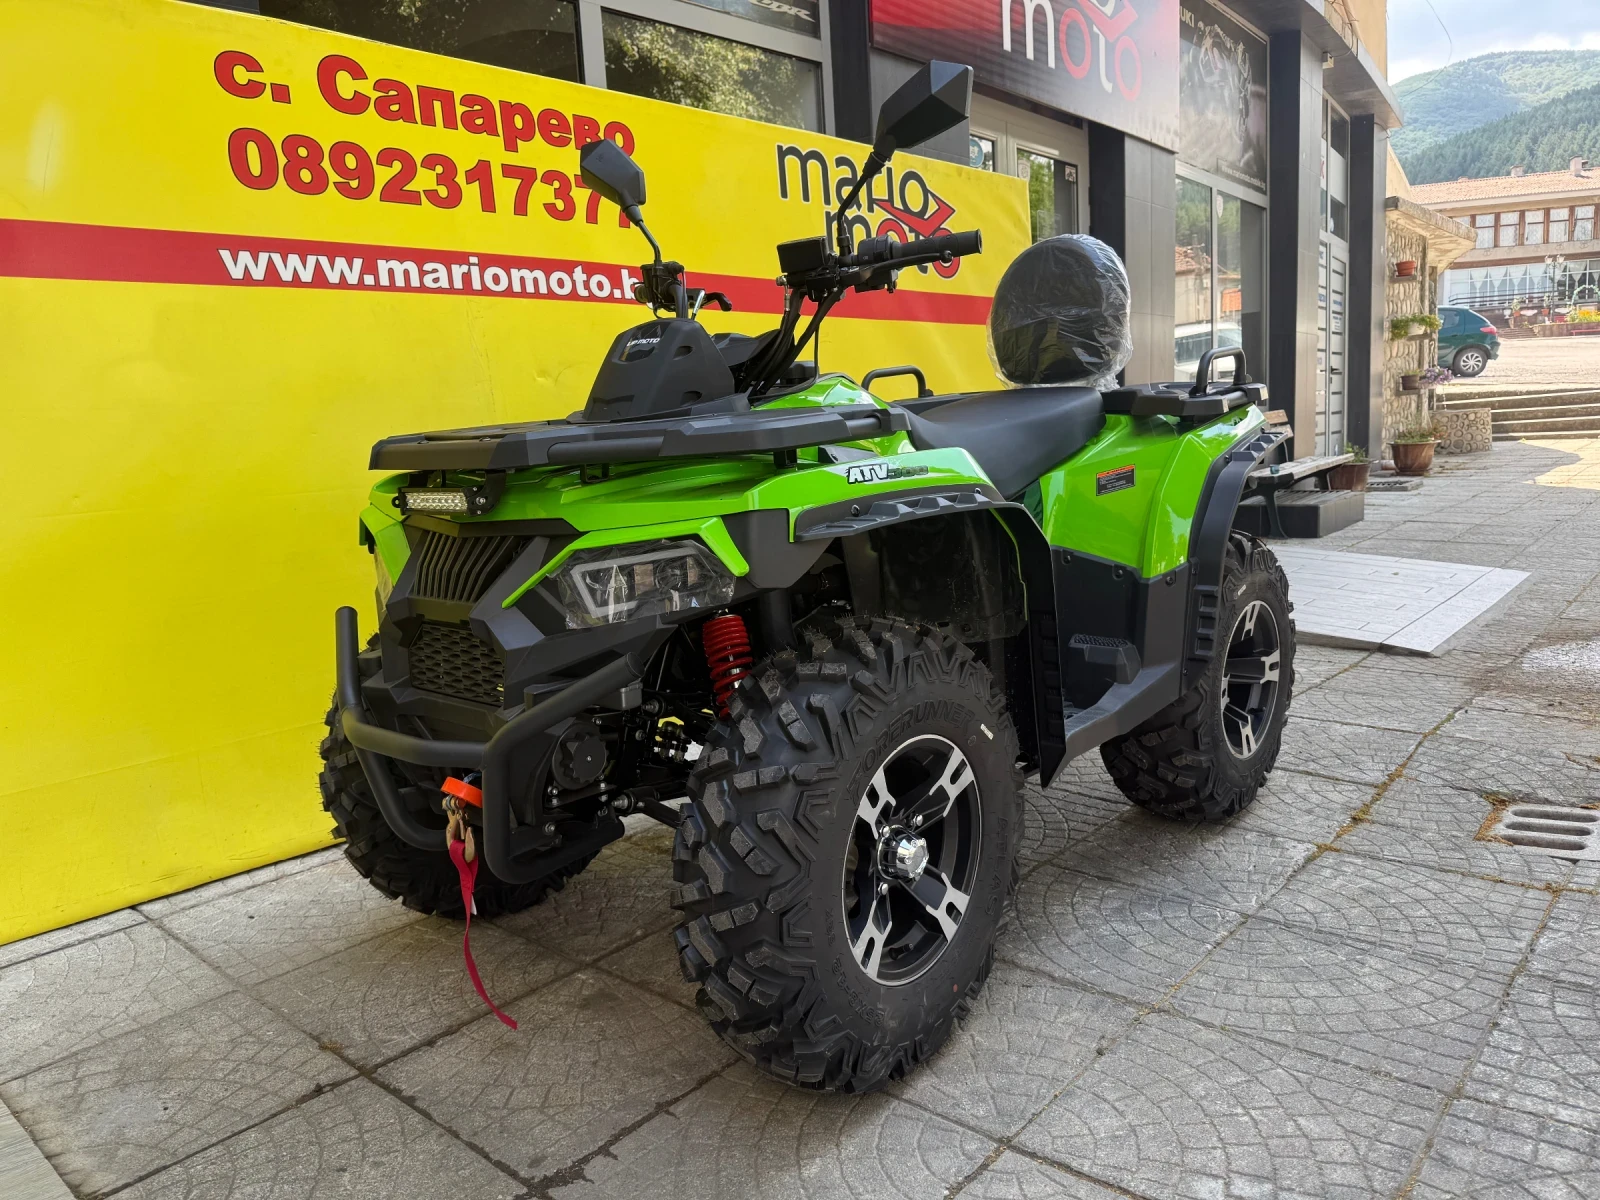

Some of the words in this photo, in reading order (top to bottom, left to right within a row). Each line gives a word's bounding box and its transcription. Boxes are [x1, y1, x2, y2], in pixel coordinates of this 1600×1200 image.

[1001, 0, 1142, 101] moto
[316, 54, 635, 157] Сапарево
[227, 127, 631, 228] 089231737
[217, 247, 640, 300] www.mariomoto.b
